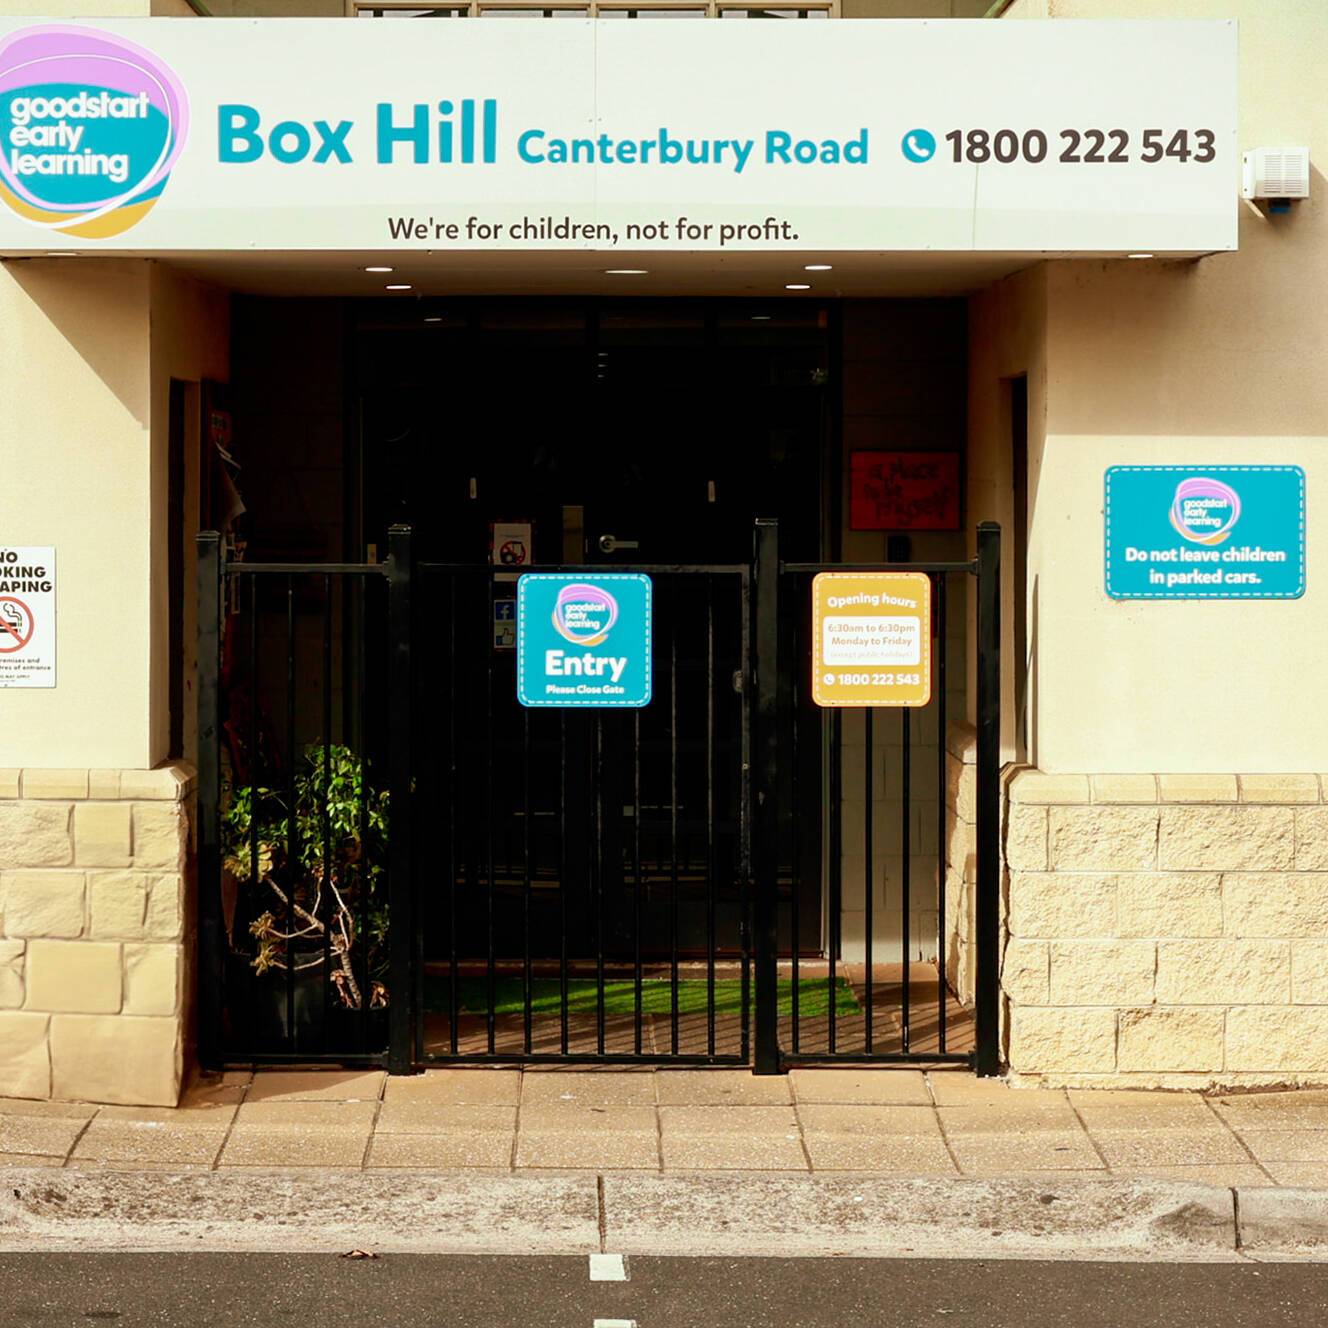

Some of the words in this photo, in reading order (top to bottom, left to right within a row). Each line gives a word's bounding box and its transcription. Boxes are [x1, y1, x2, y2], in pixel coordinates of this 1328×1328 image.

[10, 90, 150, 120] goodstart
[9, 122, 84, 151] early
[216, 103, 354, 165] Box
[376, 99, 497, 165] Hill
[517, 128, 754, 173] Canterbury
[765, 128, 869, 165] Road
[945, 129, 1048, 164] 1800
[1058, 129, 1130, 164] 222
[1140, 129, 1217, 164] 543
[10, 149, 129, 182] learning
[388, 217, 460, 240] We're
[465, 216, 504, 240] for
[509, 216, 620, 244] children,
[626, 218, 672, 240] not
[676, 217, 713, 240] for
[719, 217, 800, 245] profit.
[1183, 499, 1227, 509] goodstart
[1183, 508, 1207, 518] early
[1183, 516, 1221, 528] learning
[1125, 547, 1148, 562] Do
[1150, 548, 1178, 562] not
[1180, 547, 1220, 562] leave
[1222, 547, 1286, 562] children
[1149, 569, 1165, 584] in
[1167, 569, 1222, 588] parked
[1224, 572, 1262, 584] cars.
[827, 592, 880, 608] Opening
[882, 592, 918, 609] hours
[565, 619, 600, 630] learning
[866, 624, 876, 633] to
[831, 637, 868, 647] Monday
[871, 637, 880, 646] to
[883, 637, 913, 647] Friday
[545, 650, 627, 682] Entry
[838, 674, 870, 686] 1800
[871, 674, 894, 686] 222
[896, 674, 920, 686] 543
[546, 684, 575, 694] Please
[576, 684, 602, 694] Close
[603, 684, 624, 694] Gate
